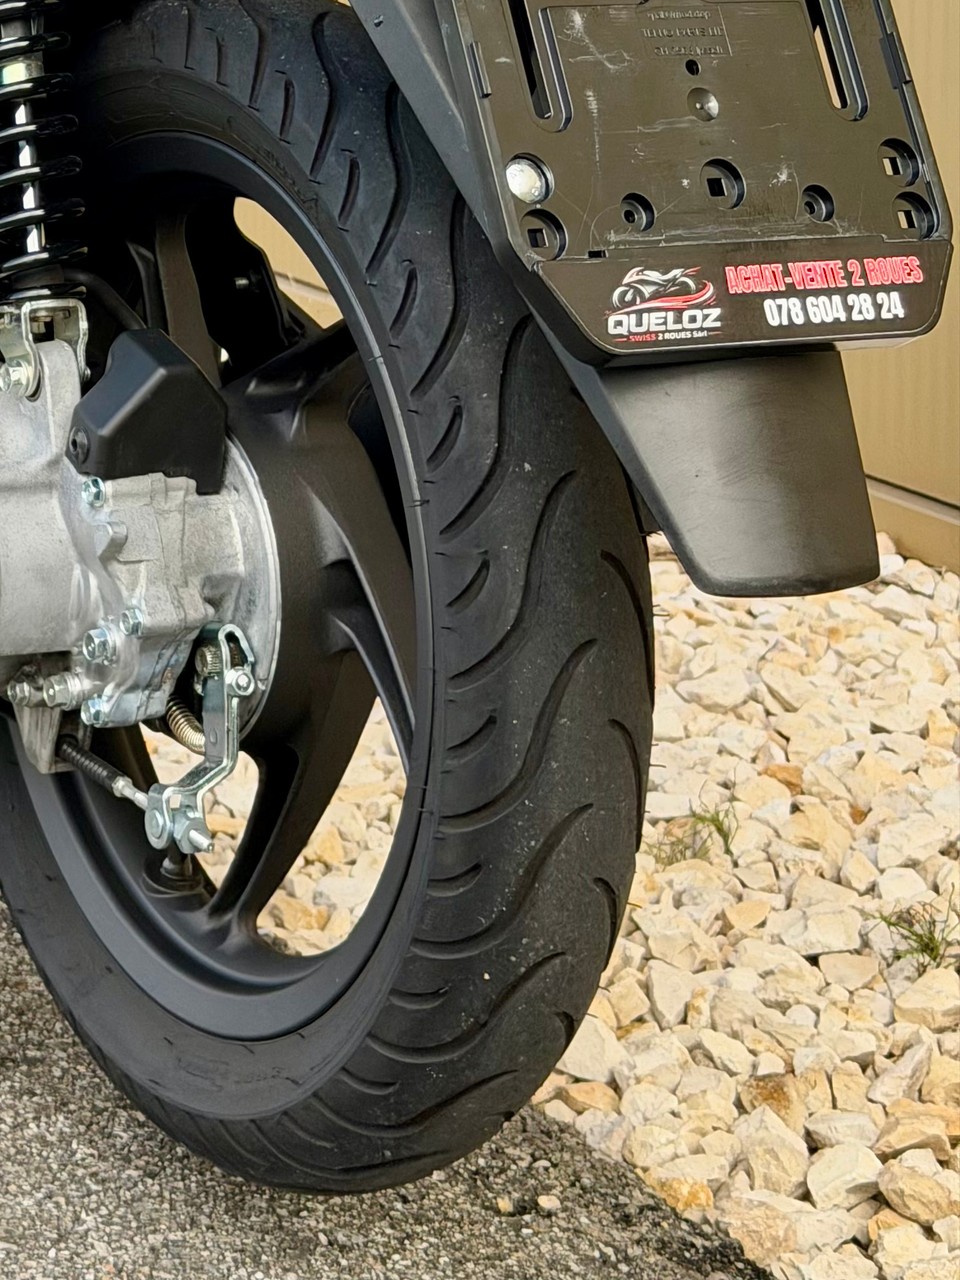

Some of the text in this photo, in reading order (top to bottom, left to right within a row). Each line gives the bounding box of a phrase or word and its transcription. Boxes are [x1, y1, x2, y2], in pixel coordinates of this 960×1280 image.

[725, 256, 924, 295] ACHAT-VENTE 2 ROUES
[607, 307, 722, 335] QUELOZ
[763, 291, 905, 327] 078 604 28 24
[629, 333, 657, 342] SWISS
[657, 332, 664, 341] 2
[664, 330, 692, 340] ROUES
